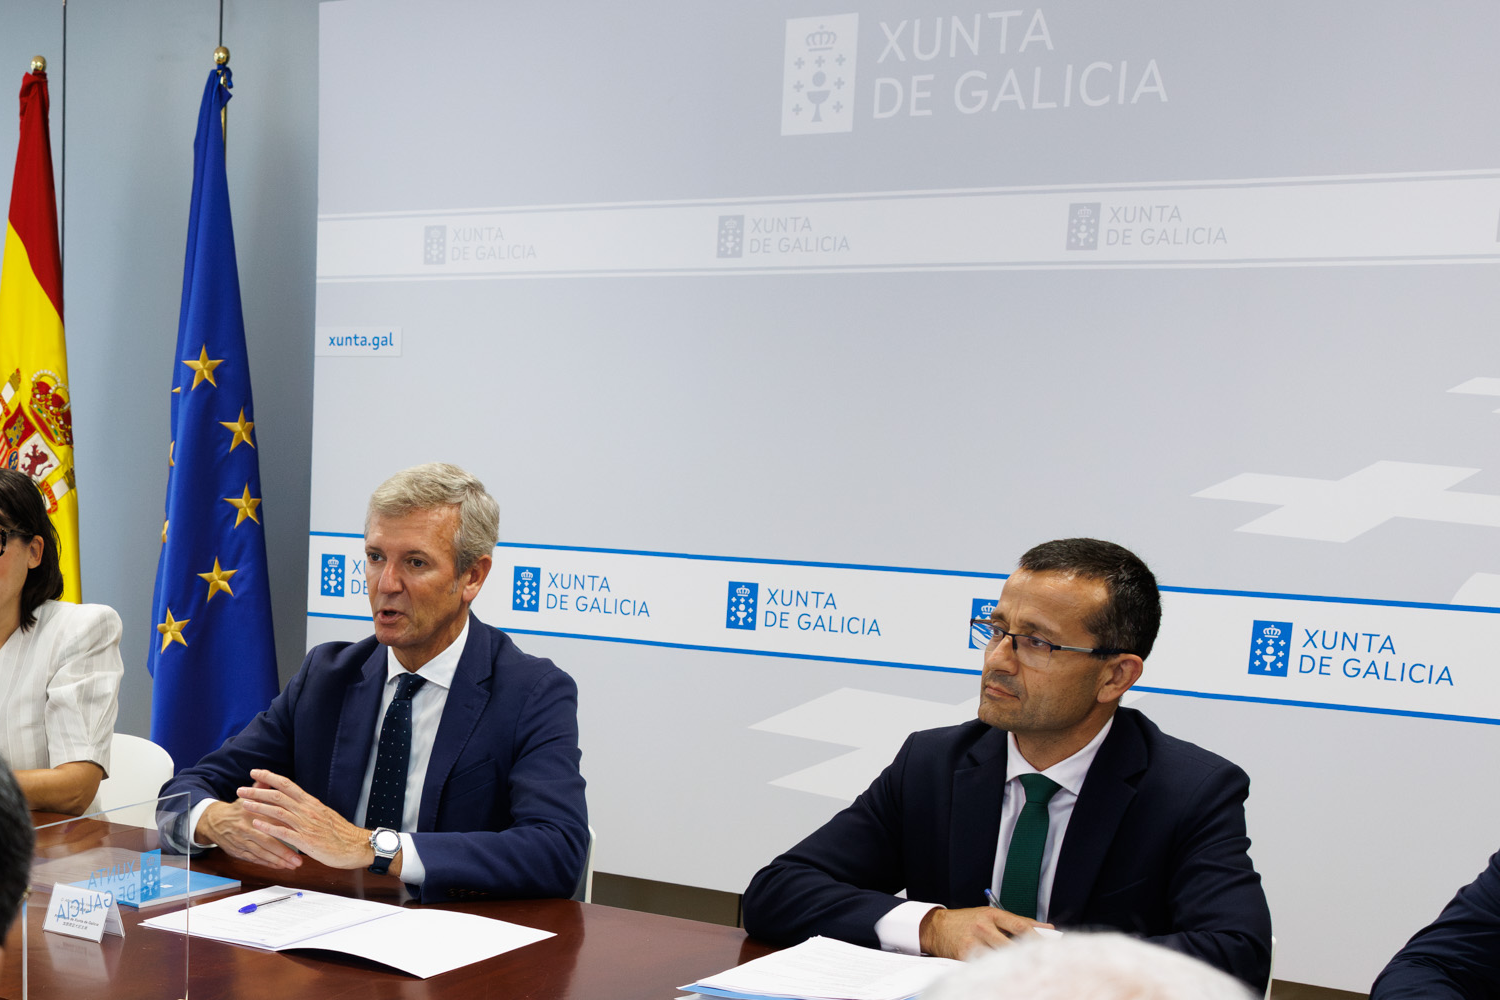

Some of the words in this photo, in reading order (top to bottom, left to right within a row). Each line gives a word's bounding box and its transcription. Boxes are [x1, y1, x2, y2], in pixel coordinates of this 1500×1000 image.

[876, 7, 1055, 64] XUNTA
[872, 76, 934, 120] DE
[953, 58, 1169, 115] GALICIA
[750, 216, 813, 234] XUNTA
[1108, 205, 1183, 225] XUNTA
[452, 226, 505, 242] XUNTA
[749, 238, 773, 254] DE
[777, 235, 851, 254] GALICIA
[1105, 228, 1133, 246] DE
[1139, 226, 1228, 246] GALICIA
[450, 246, 470, 261] DE
[474, 244, 537, 260] GALICIA
[328, 332, 394, 350] xunta.gal
[547, 572, 611, 593] XUNTA
[546, 593, 569, 610] DE
[574, 596, 650, 618] GALICIA
[766, 587, 838, 610] XUNTA
[763, 611, 791, 629] DE
[797, 612, 882, 637] GALICIA
[1302, 628, 1397, 655] XUNTA
[1298, 654, 1334, 675] DE
[1341, 658, 1455, 687] GALICIA
